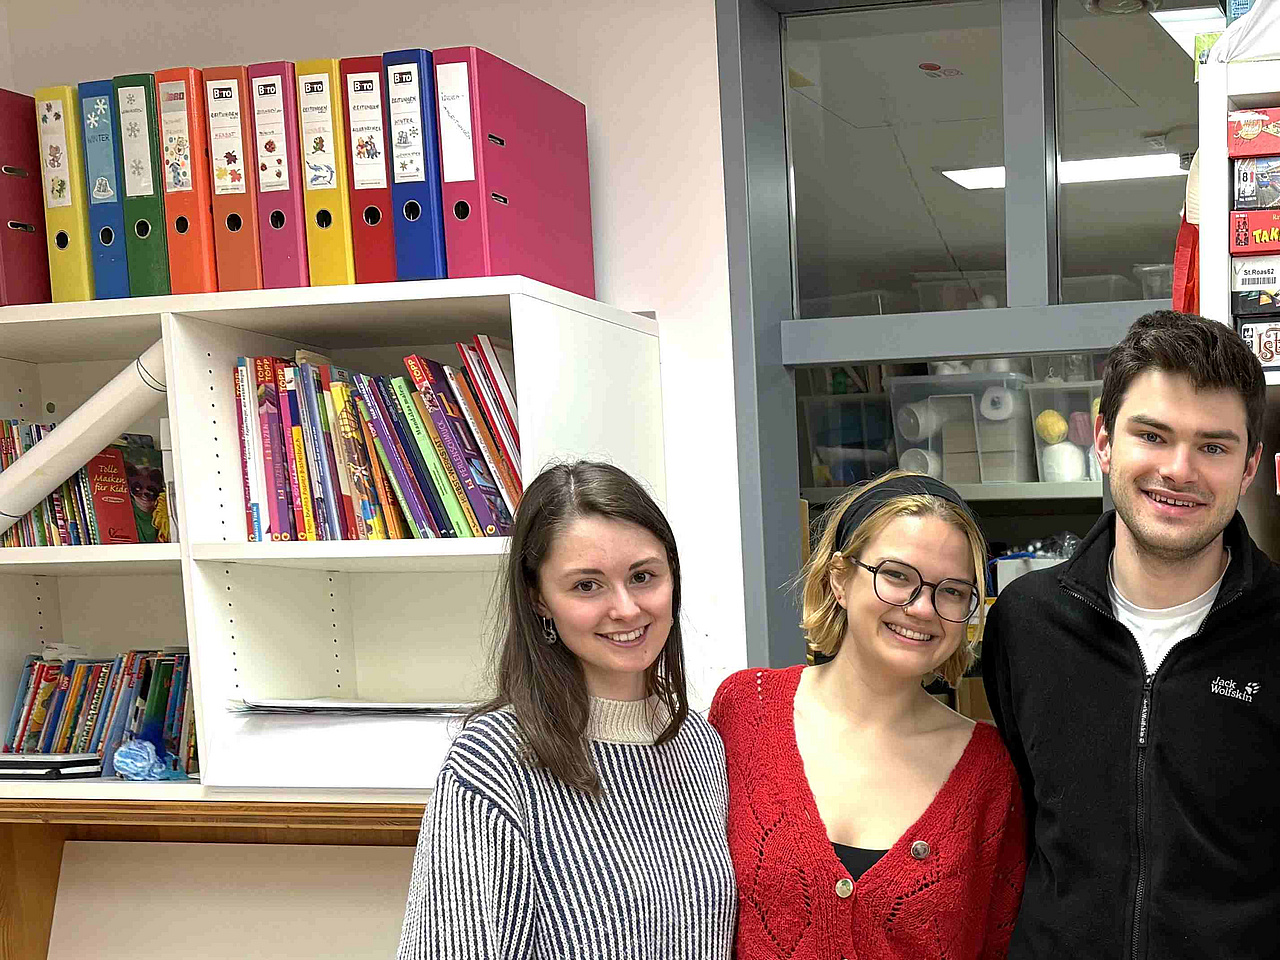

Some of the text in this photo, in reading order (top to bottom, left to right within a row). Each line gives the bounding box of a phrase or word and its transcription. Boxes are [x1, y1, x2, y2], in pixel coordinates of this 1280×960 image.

[408, 360, 422, 381] TOPP
[99, 465, 118, 473] Tolle
[1212, 677, 1236, 689] Jack
[1211, 684, 1252, 702] Wolfskin
